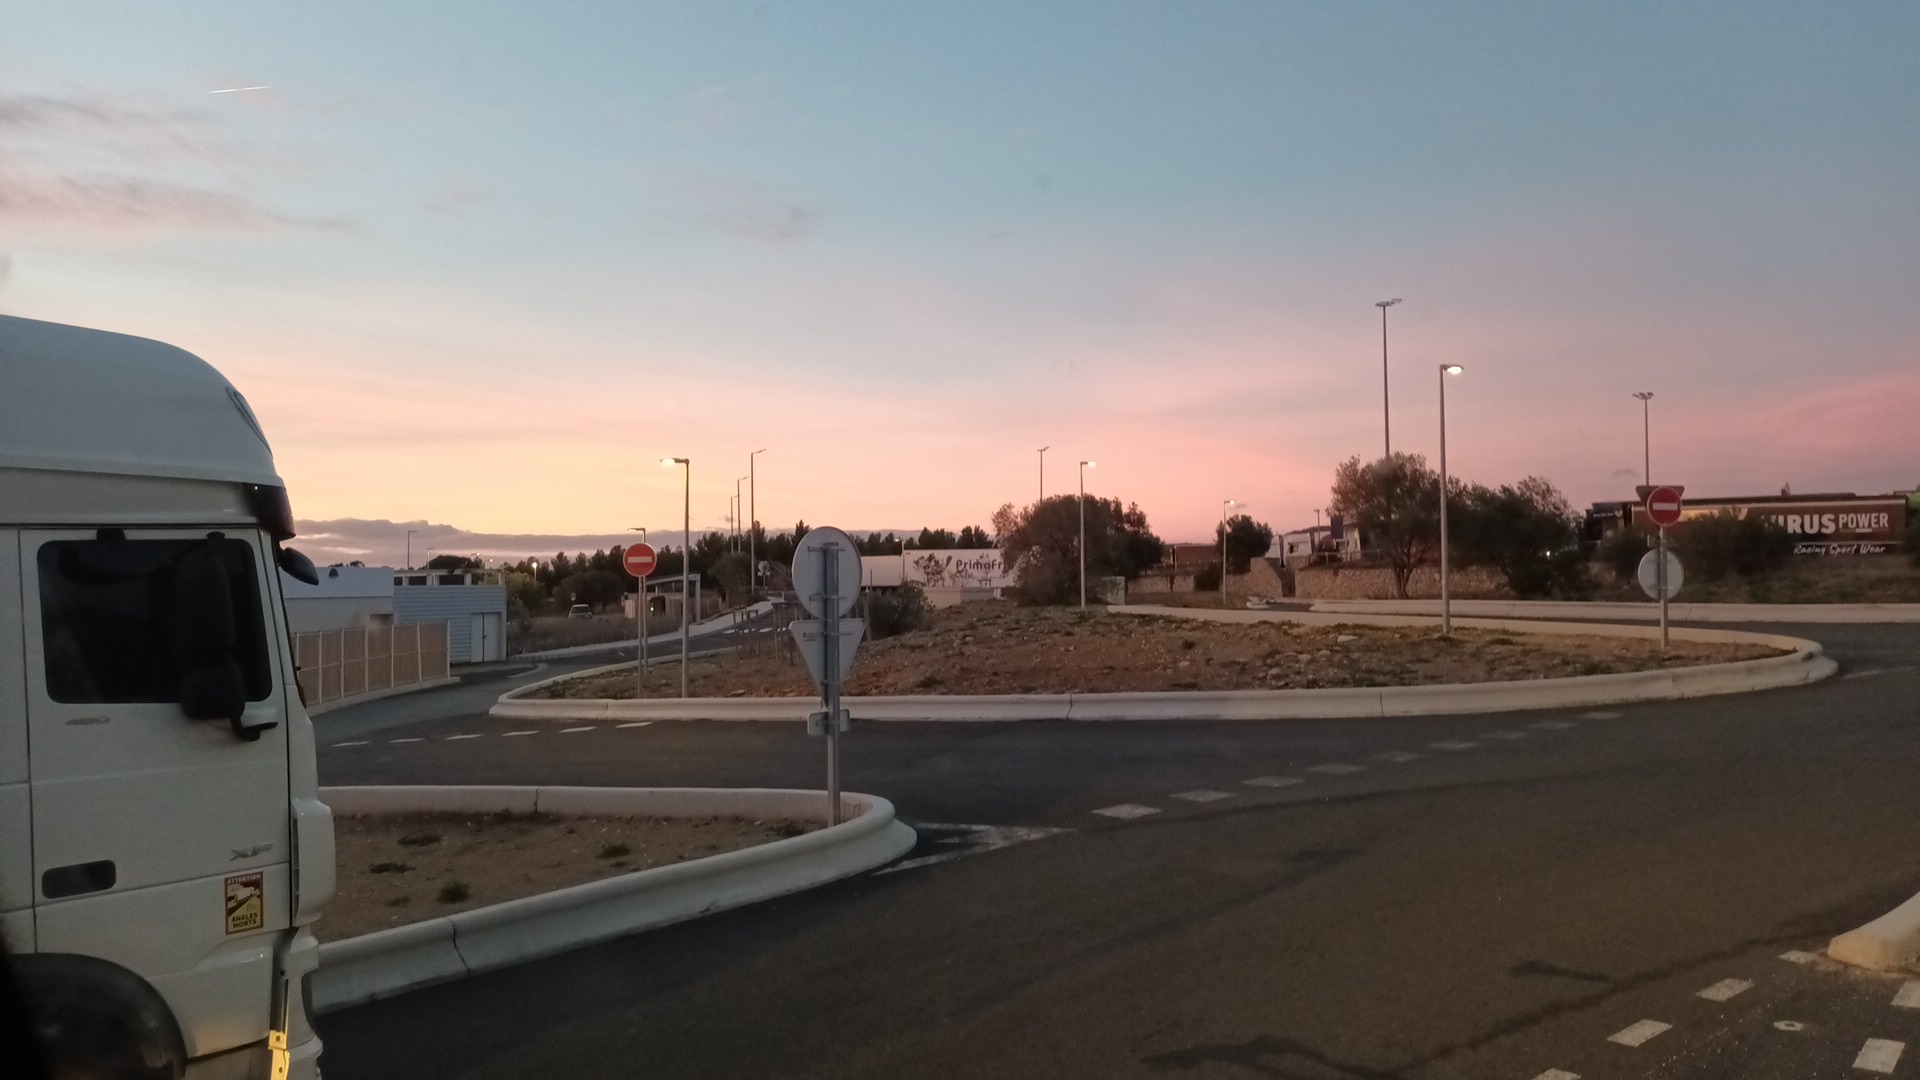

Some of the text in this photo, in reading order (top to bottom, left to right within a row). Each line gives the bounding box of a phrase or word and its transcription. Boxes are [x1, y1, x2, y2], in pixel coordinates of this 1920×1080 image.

[1839, 513, 1888, 528] POWER
[1793, 543, 1886, 555] Racing Sport Wear
[228, 874, 261, 884] ATTENTION
[232, 913, 257, 922] ANGLES
[233, 920, 256, 928] MORTS
